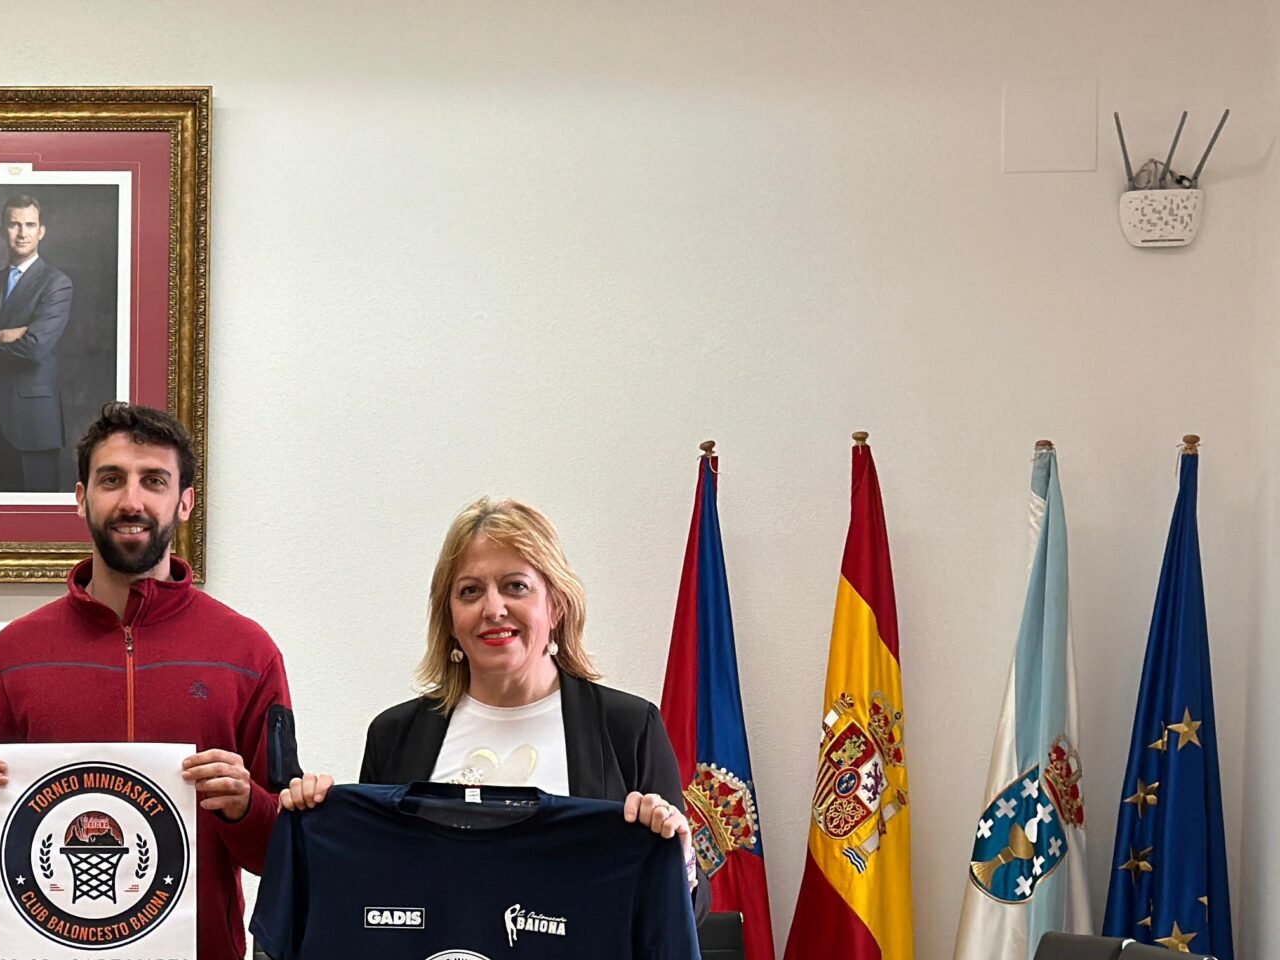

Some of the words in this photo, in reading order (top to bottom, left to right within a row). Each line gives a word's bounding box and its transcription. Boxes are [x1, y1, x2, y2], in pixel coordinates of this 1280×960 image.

[28, 776, 80, 814] TORNEO
[83, 772, 166, 817] MINIBASKET
[21, 890, 47, 922] CLUB
[46, 916, 130, 942] BALONCESTO
[130, 889, 170, 931] BAIONA
[367, 910, 422, 925] GADIS
[516, 917, 566, 936] BAIONA
